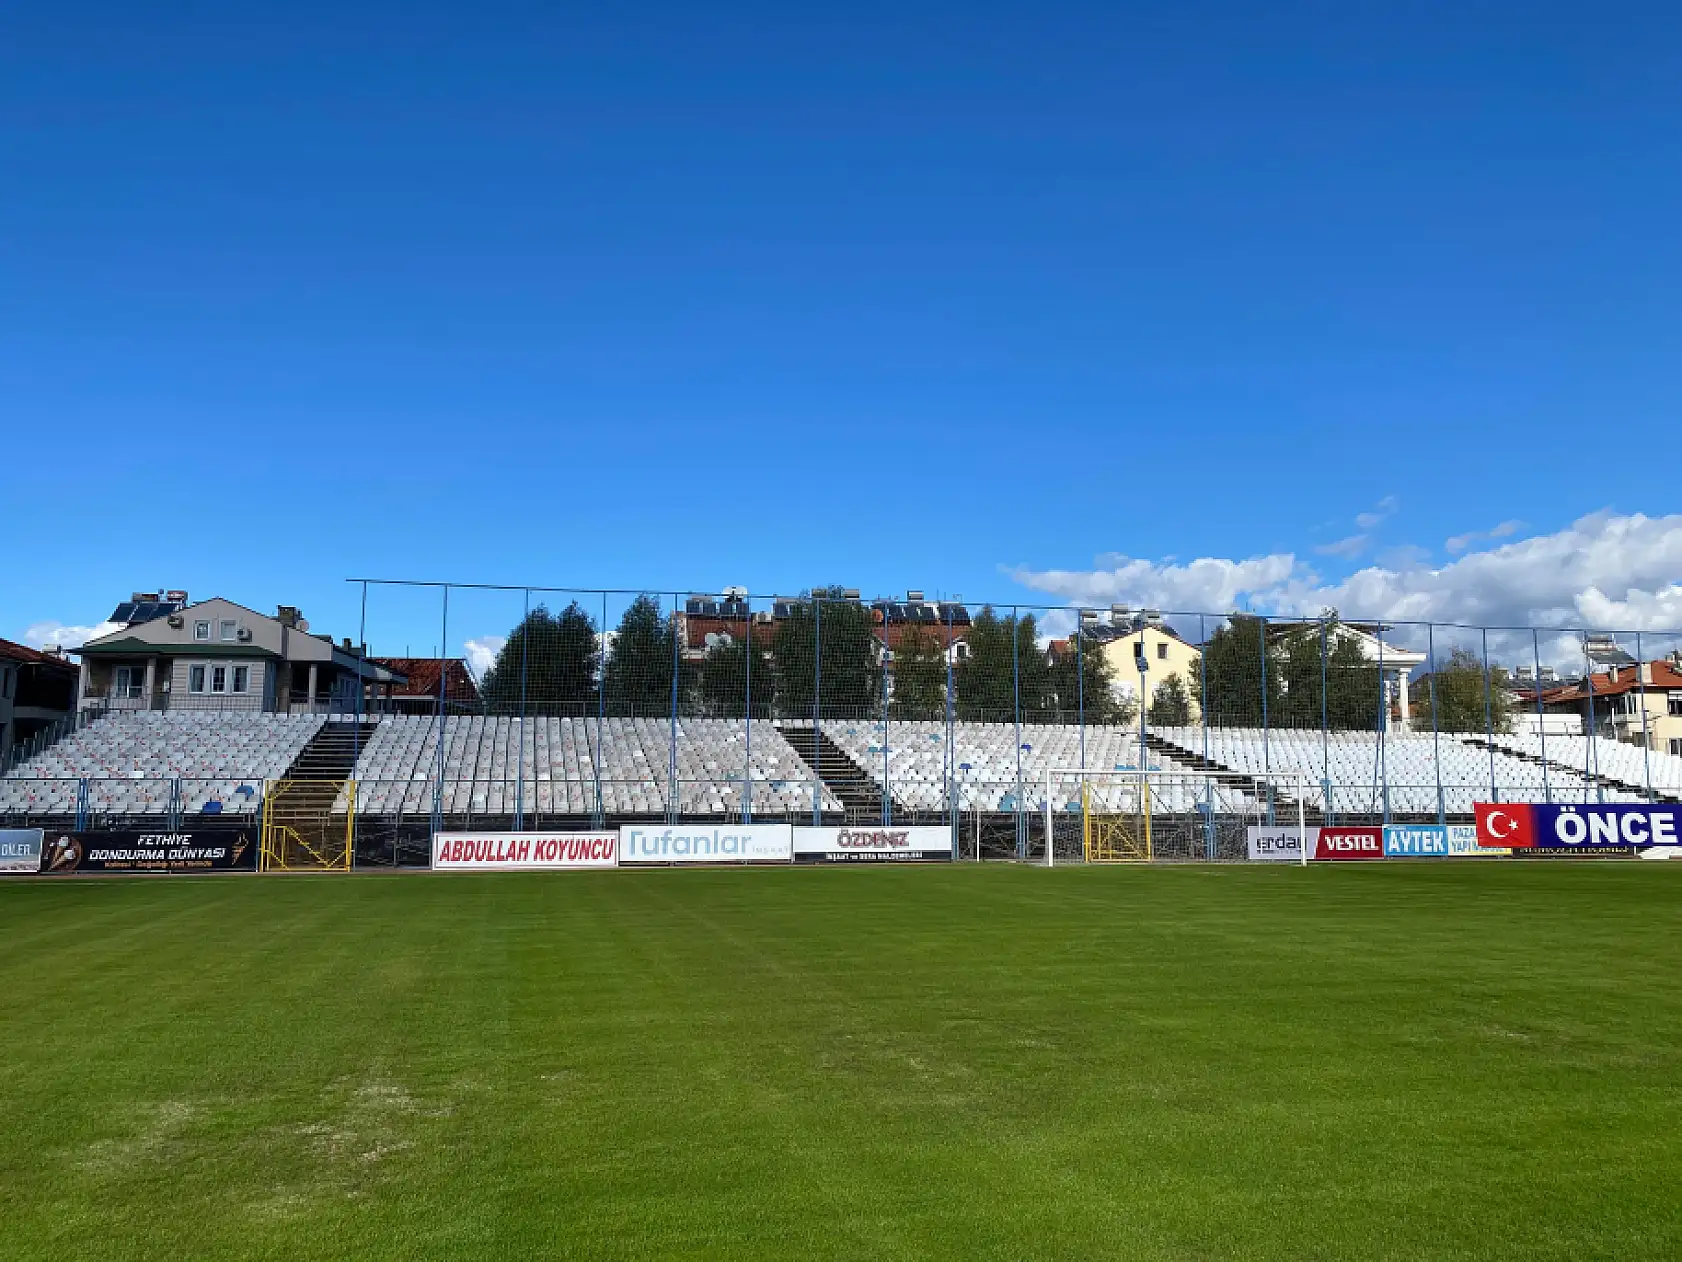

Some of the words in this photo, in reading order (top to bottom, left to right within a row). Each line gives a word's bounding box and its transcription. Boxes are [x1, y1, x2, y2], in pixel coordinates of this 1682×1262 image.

[1555, 806, 1679, 844] ÖNCE
[137, 833, 192, 846] FETHİYE
[630, 829, 752, 856] Tufanlar
[837, 828, 910, 848] ÖZDENİZ
[1324, 834, 1379, 851] VESTEL
[1388, 830, 1445, 853] AYTEK
[88, 849, 165, 860] DONDURMA
[168, 846, 226, 860] DÜNYASI
[439, 840, 531, 862] ABDULLAH
[533, 838, 616, 862] KOYUNCU
